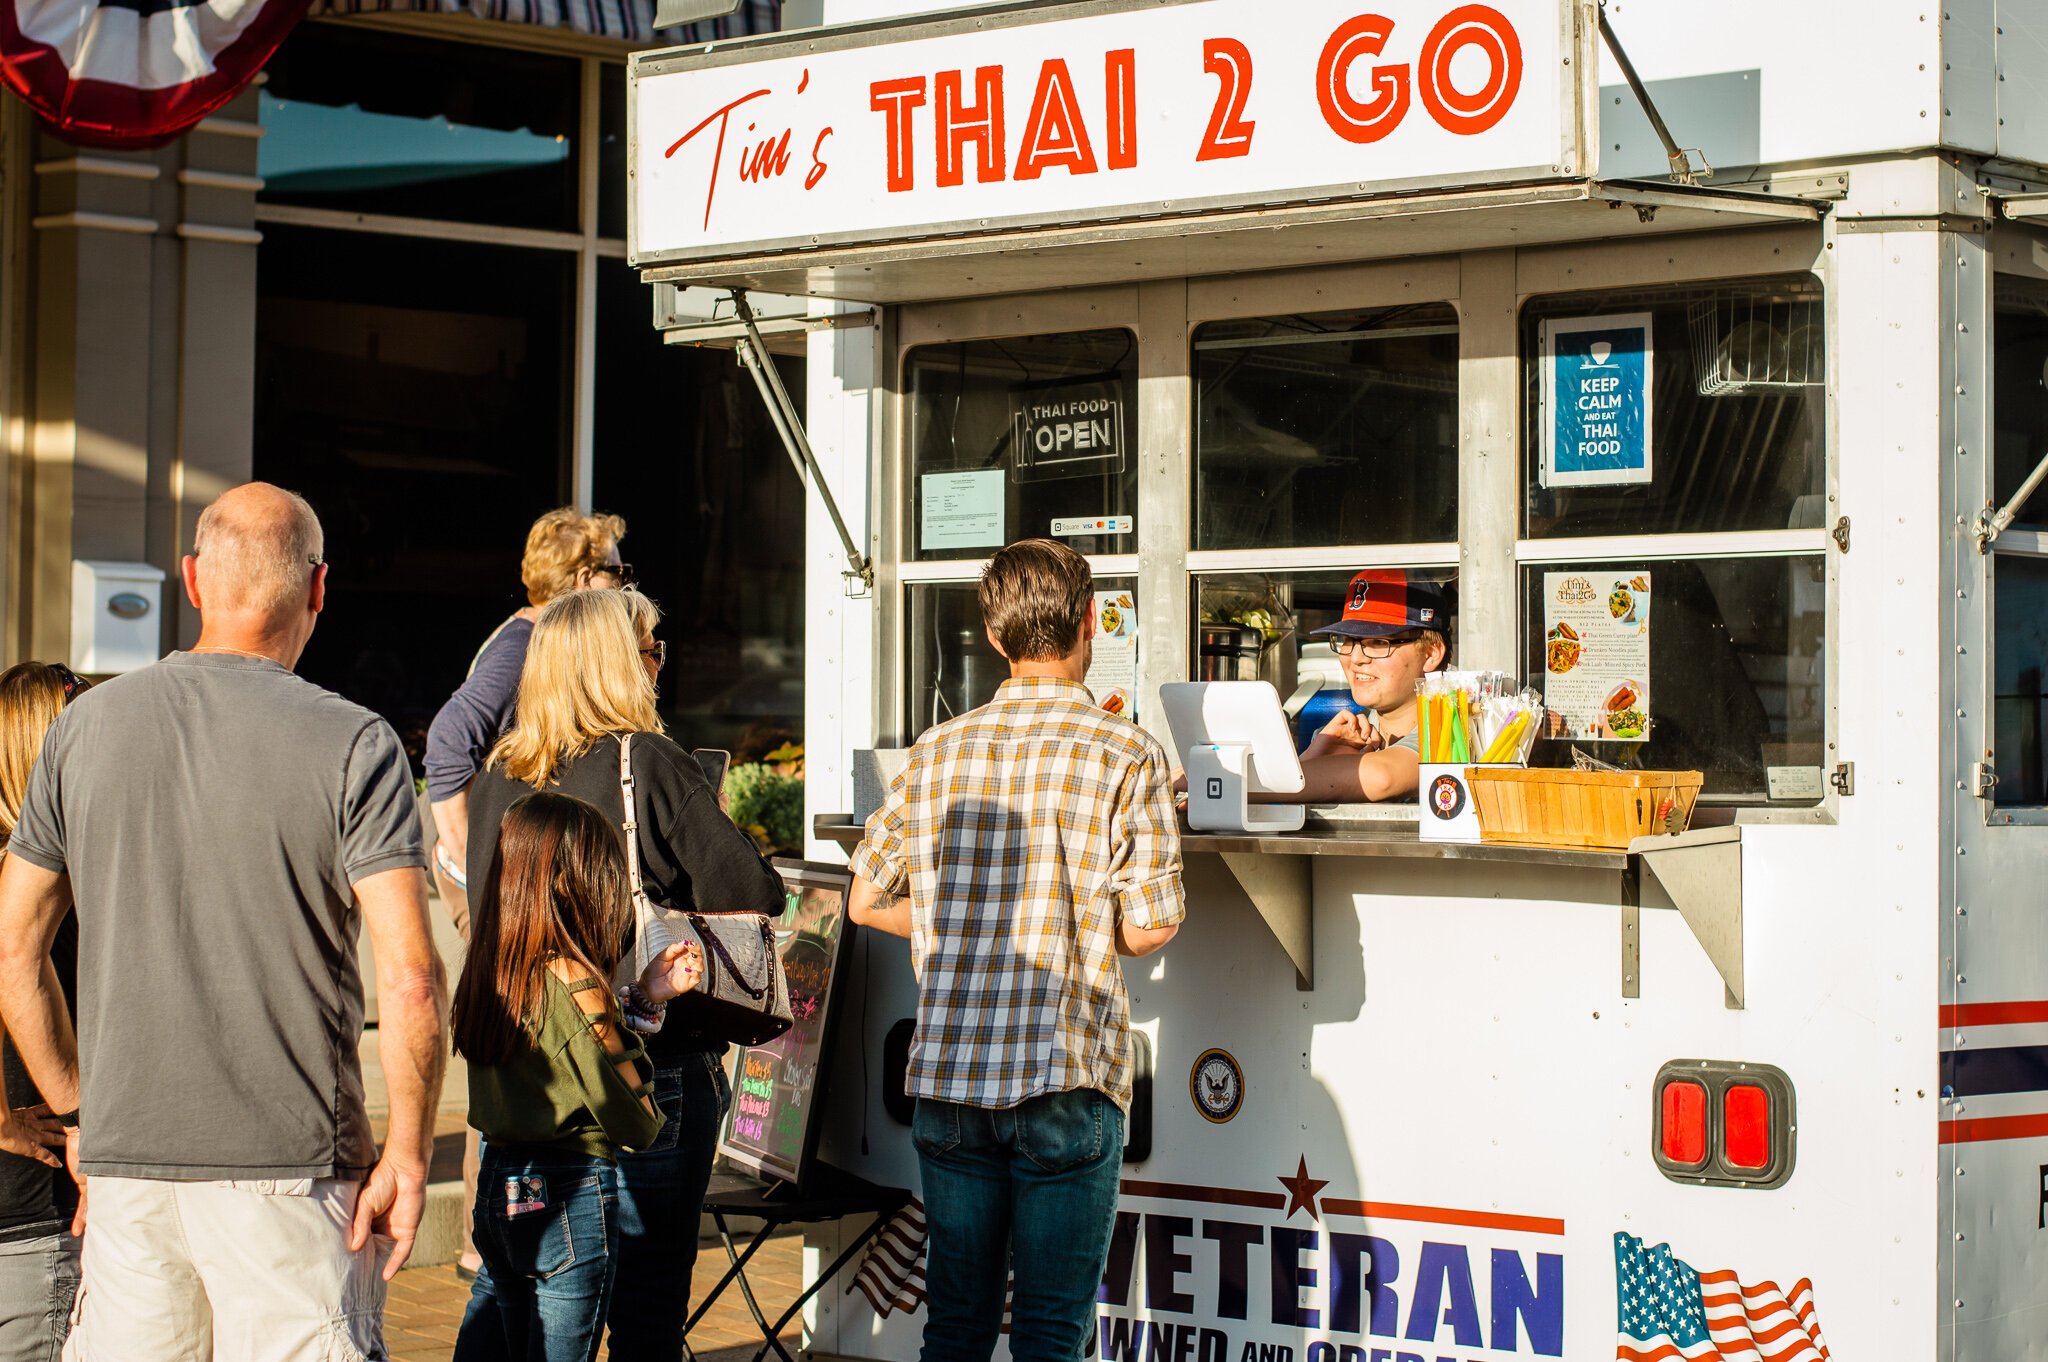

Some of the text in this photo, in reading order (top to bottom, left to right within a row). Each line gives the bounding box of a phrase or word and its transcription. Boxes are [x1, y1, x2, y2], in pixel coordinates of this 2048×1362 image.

[664, 3, 1523, 232] Tim's THAI 2 GO
[1581, 377, 1620, 393] KEEP
[1032, 398, 1109, 419] THAI FOOD
[1578, 394, 1622, 410] CALM
[1584, 411, 1616, 421] AND EAT
[1035, 417, 1111, 453] OPEN
[1582, 422, 1617, 439] THAI
[1578, 440, 1621, 456] FOOD
[1565, 579, 1591, 590] Tim's
[1348, 578, 1369, 610] B
